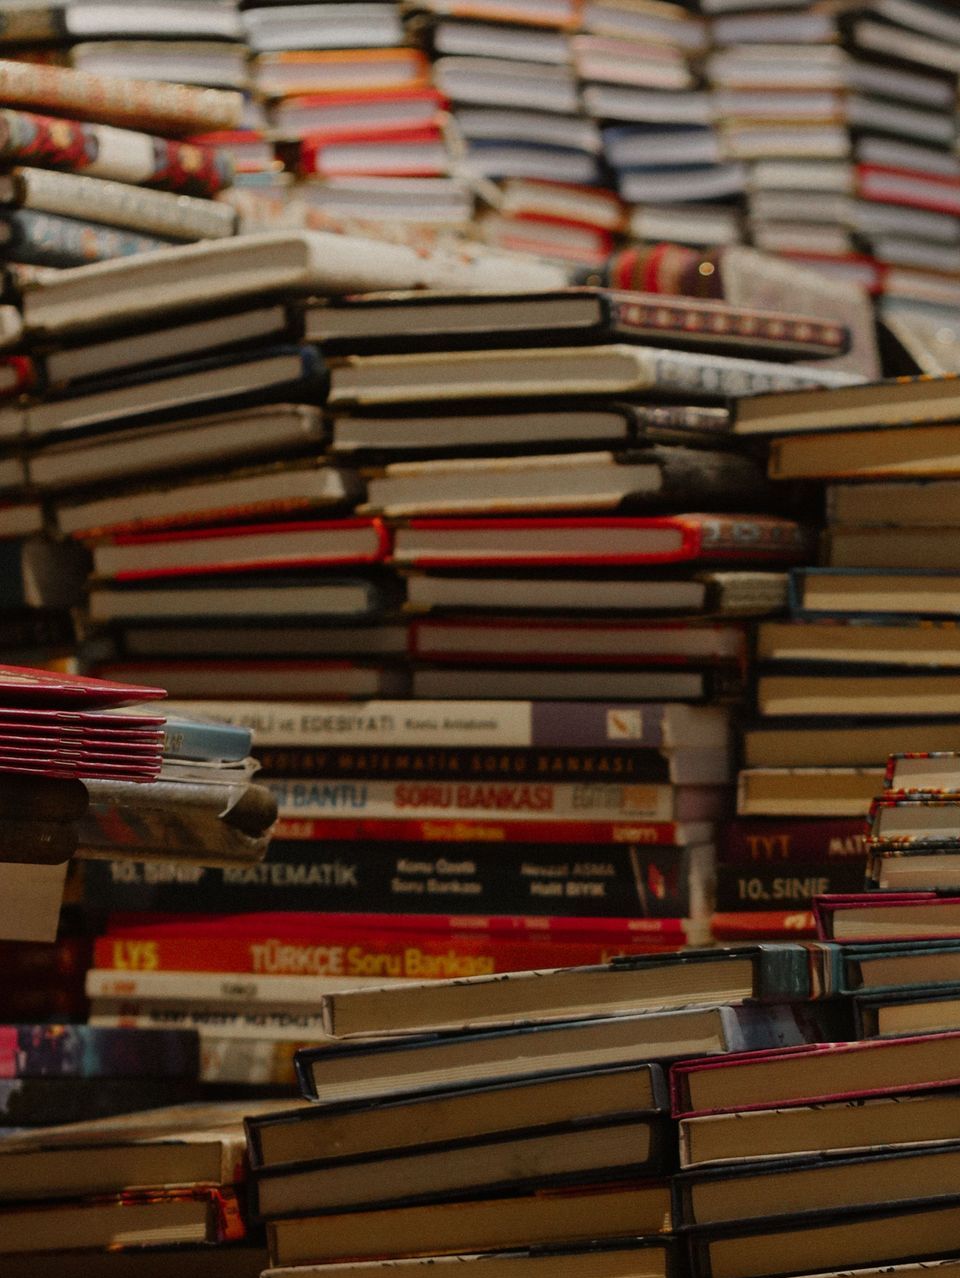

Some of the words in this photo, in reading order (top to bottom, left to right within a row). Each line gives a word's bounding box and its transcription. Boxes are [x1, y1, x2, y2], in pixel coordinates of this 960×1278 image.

[394, 784, 451, 808] SORU
[457, 785, 554, 811] BANKASI
[747, 834, 792, 861] TYT
[737, 877, 770, 901] 10.
[772, 877, 831, 900] SINIF
[113, 938, 159, 971] LYS
[250, 938, 345, 976] TÜRKÇE
[346, 945, 400, 978] Soru
[403, 947, 495, 978] Bankası
